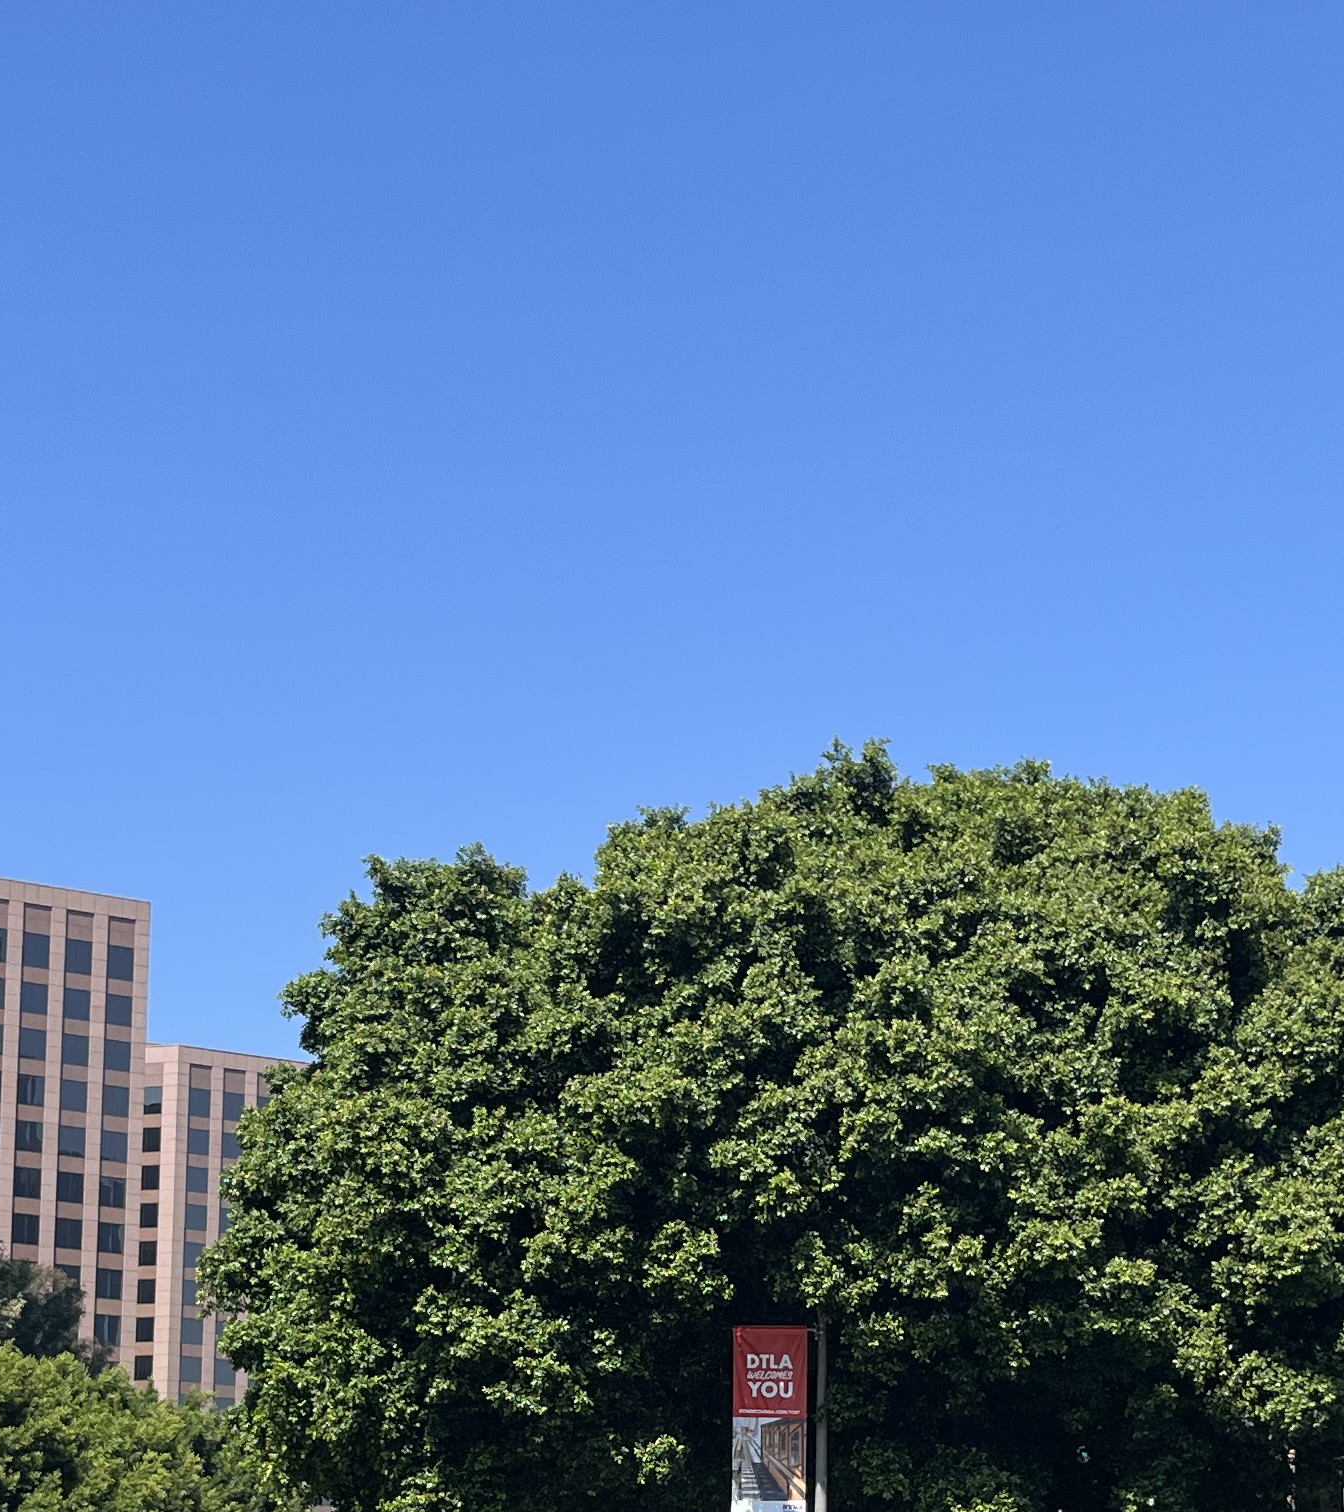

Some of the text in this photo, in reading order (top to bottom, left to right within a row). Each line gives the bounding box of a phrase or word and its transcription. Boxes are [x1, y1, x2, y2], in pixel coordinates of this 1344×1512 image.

[747, 1354, 793, 1369] DTLA
[747, 1371, 793, 1379] WELCOMES
[747, 1381, 793, 1398] YOU
